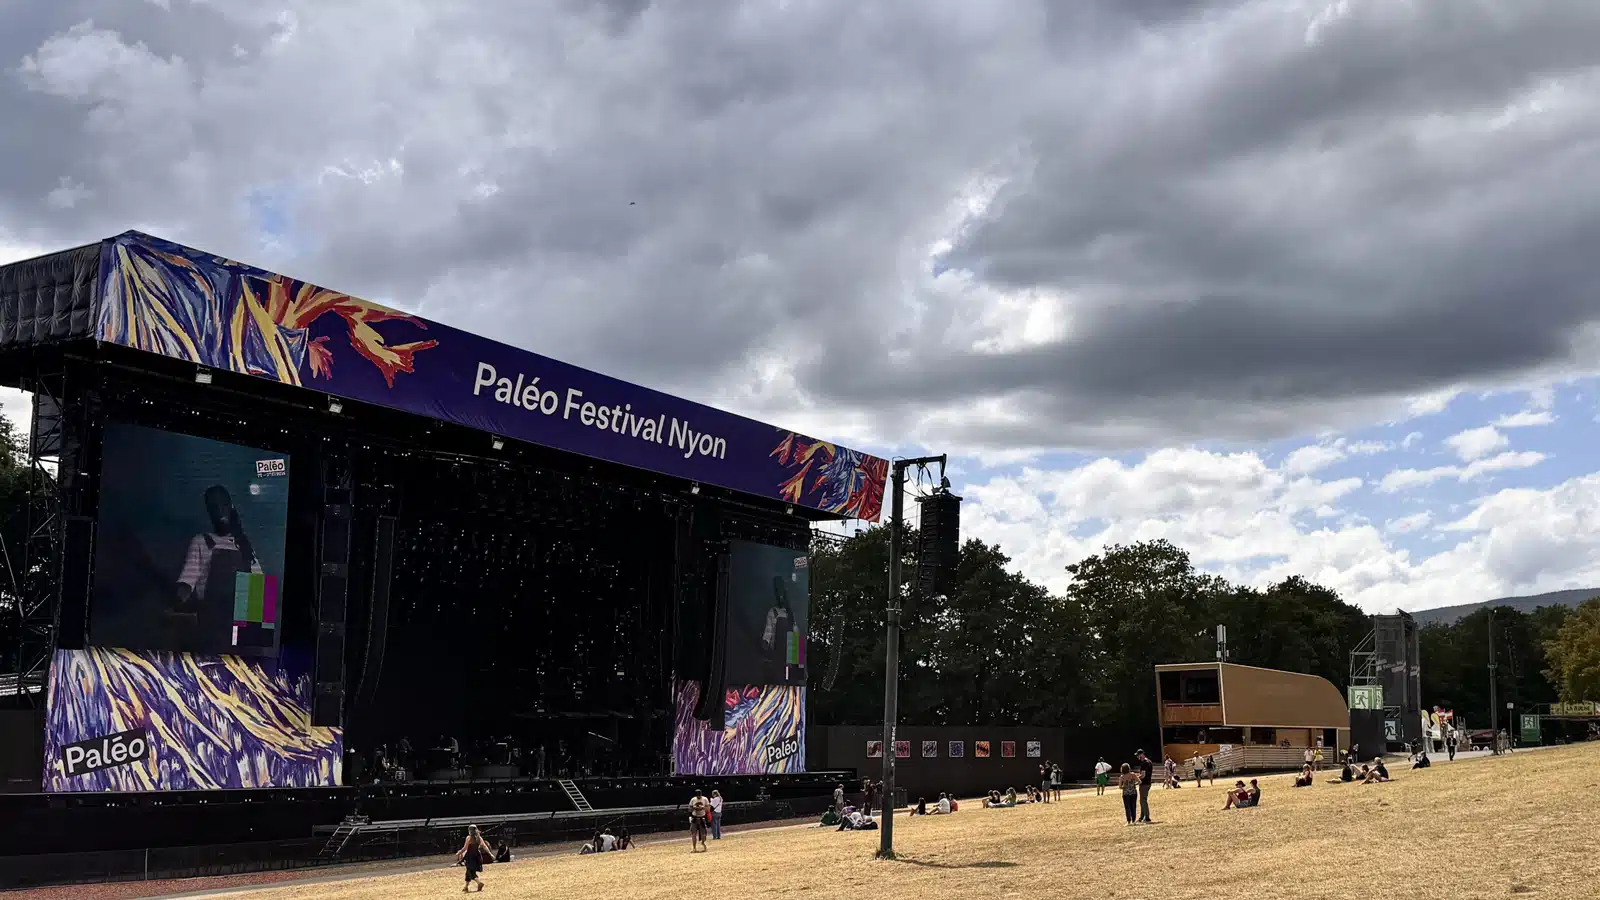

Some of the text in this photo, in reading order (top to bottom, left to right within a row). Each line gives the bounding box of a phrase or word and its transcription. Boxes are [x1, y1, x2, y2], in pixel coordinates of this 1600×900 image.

[473, 361, 727, 459] Paléo Festival Nyon
[257, 461, 284, 472] Paléo
[65, 735, 145, 774] Paléo
[767, 739, 798, 763] Paléo
